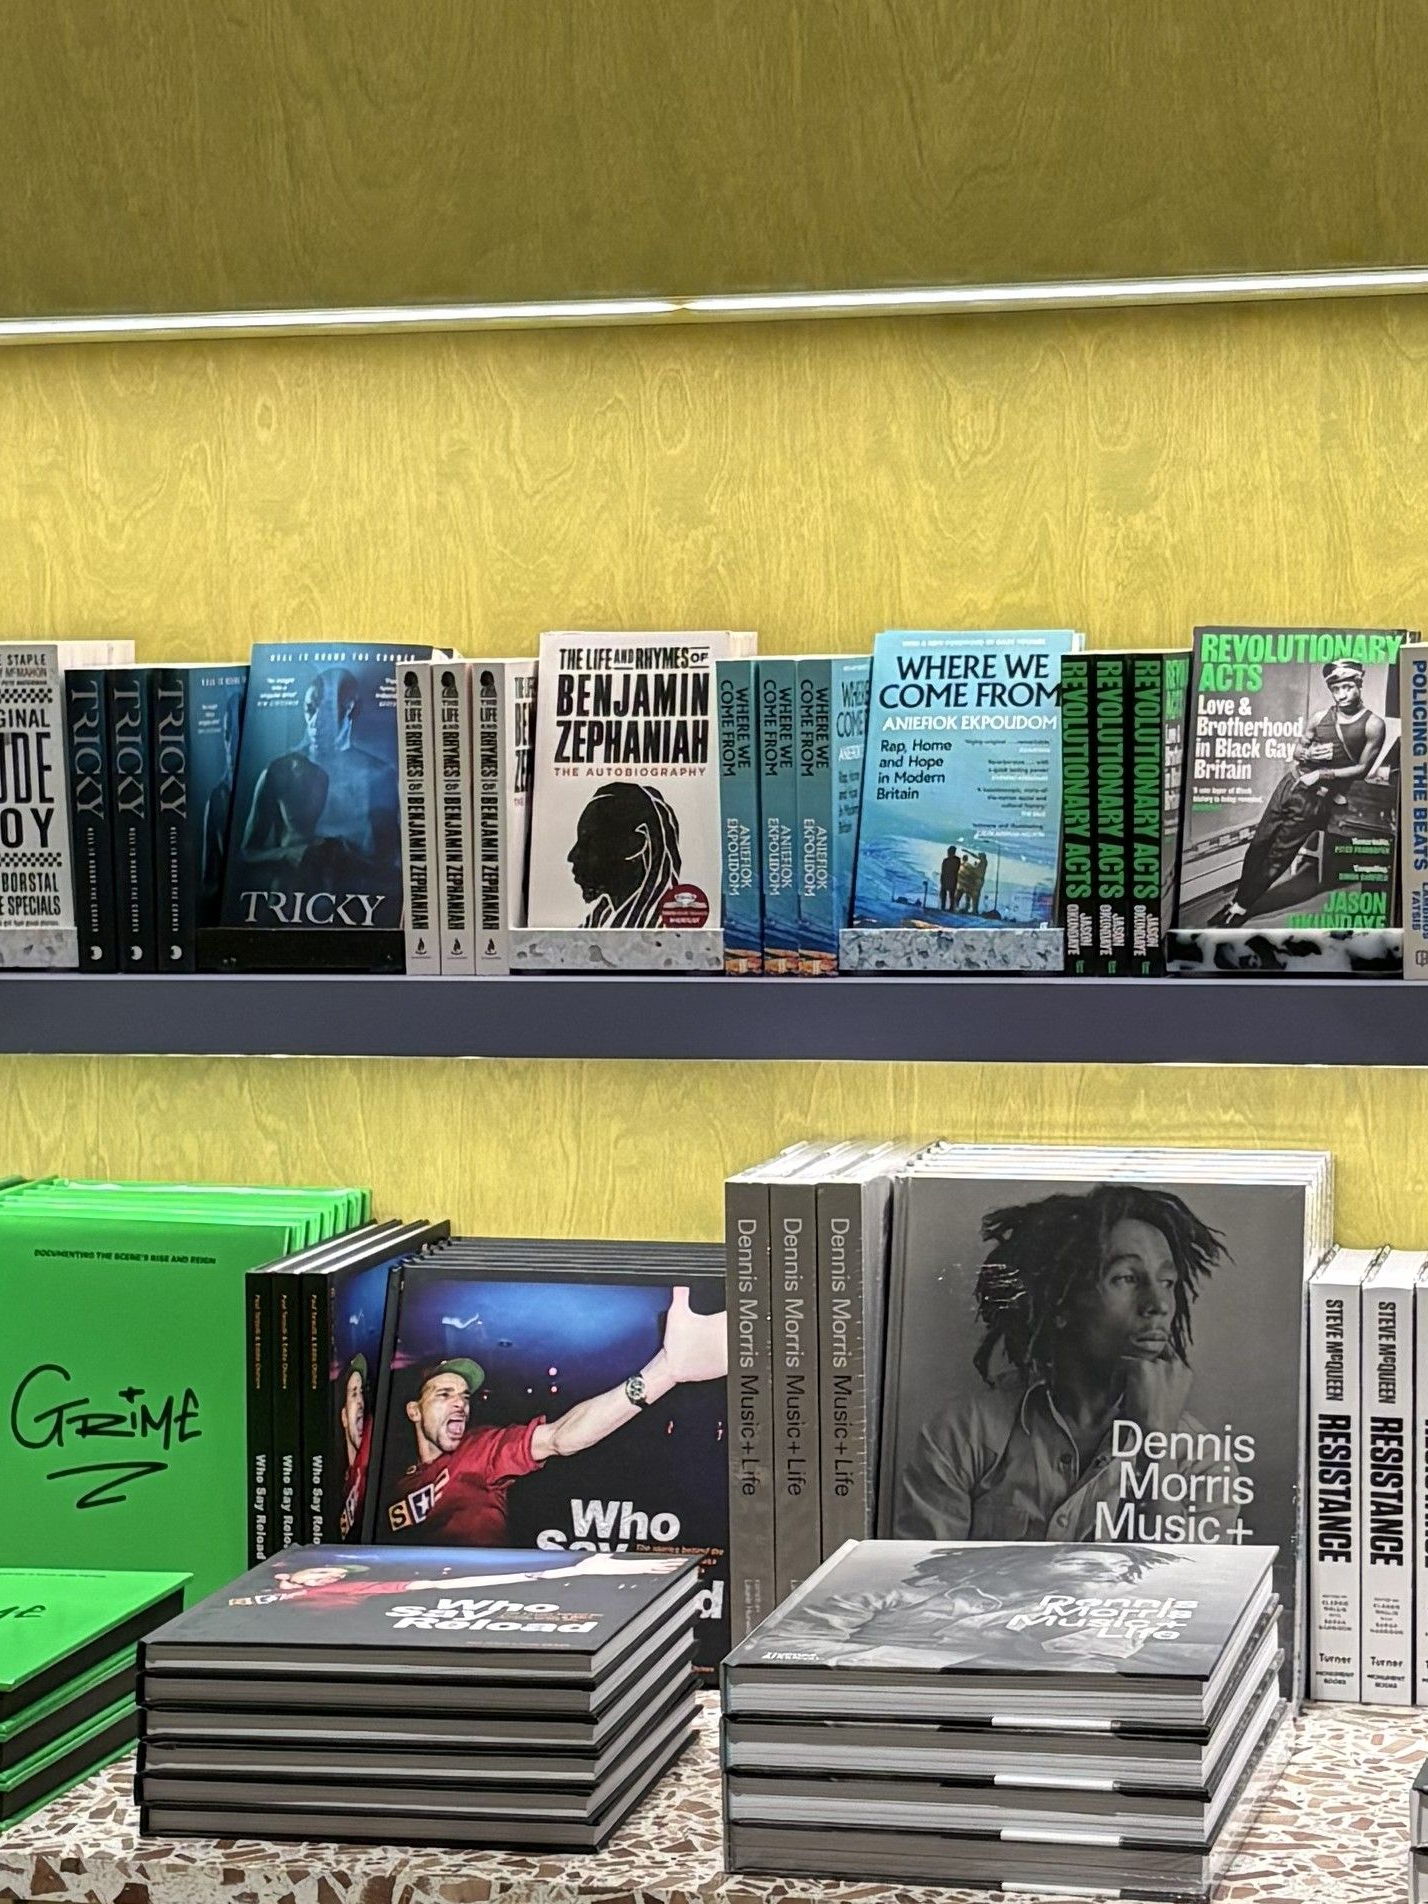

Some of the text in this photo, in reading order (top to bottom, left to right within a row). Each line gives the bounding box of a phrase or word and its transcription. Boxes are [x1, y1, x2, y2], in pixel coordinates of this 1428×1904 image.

[7, 654, 46, 666] STAPLE
[560, 647, 709, 670] THE LIFE AND RHYMES OF
[1201, 634, 1403, 665] REVOLUTIONARY
[897, 654, 1049, 680] WHERE WE
[1198, 664, 1263, 693] ACTS
[556, 673, 710, 717] BENJAMIN
[879, 682, 1062, 709] COME FROM
[1198, 695, 1252, 716] Love &
[882, 715, 1057, 731] ANIEFIOK EKPOUDOM
[1196, 717, 1304, 738] Brotherhood
[554, 720, 709, 764] ZEPHANIAH
[880, 739, 952, 755] Rap, Home
[1195, 738, 1296, 763] in Black Gay
[554, 767, 706, 777] THE AUTOBIOGRAPHY
[879, 756, 943, 770] and Hope
[1193, 760, 1252, 780] Britain
[1412, 660, 1428, 872] POLICING THE BEATS
[878, 770, 946, 783] in Modern
[876, 787, 919, 800] Britain
[2, 872, 59, 893] BORSTAL
[8, 895, 61, 916] SPECIALS
[240, 891, 385, 926] TRICKY
[1323, 891, 1387, 914] JASON
[737, 1218, 757, 1293] Dennis
[738, 1298, 759, 1369] Morris
[1112, 1418, 1256, 1464] Dennis
[1118, 1462, 1256, 1505] Morris
[1317, 1414, 1353, 1564] RESISTANCE
[254, 1454, 267, 1560] Who Say Reload
[571, 1497, 681, 1542] Who
[433, 1598, 561, 1614] Who
[392, 1617, 599, 1632] Reload
